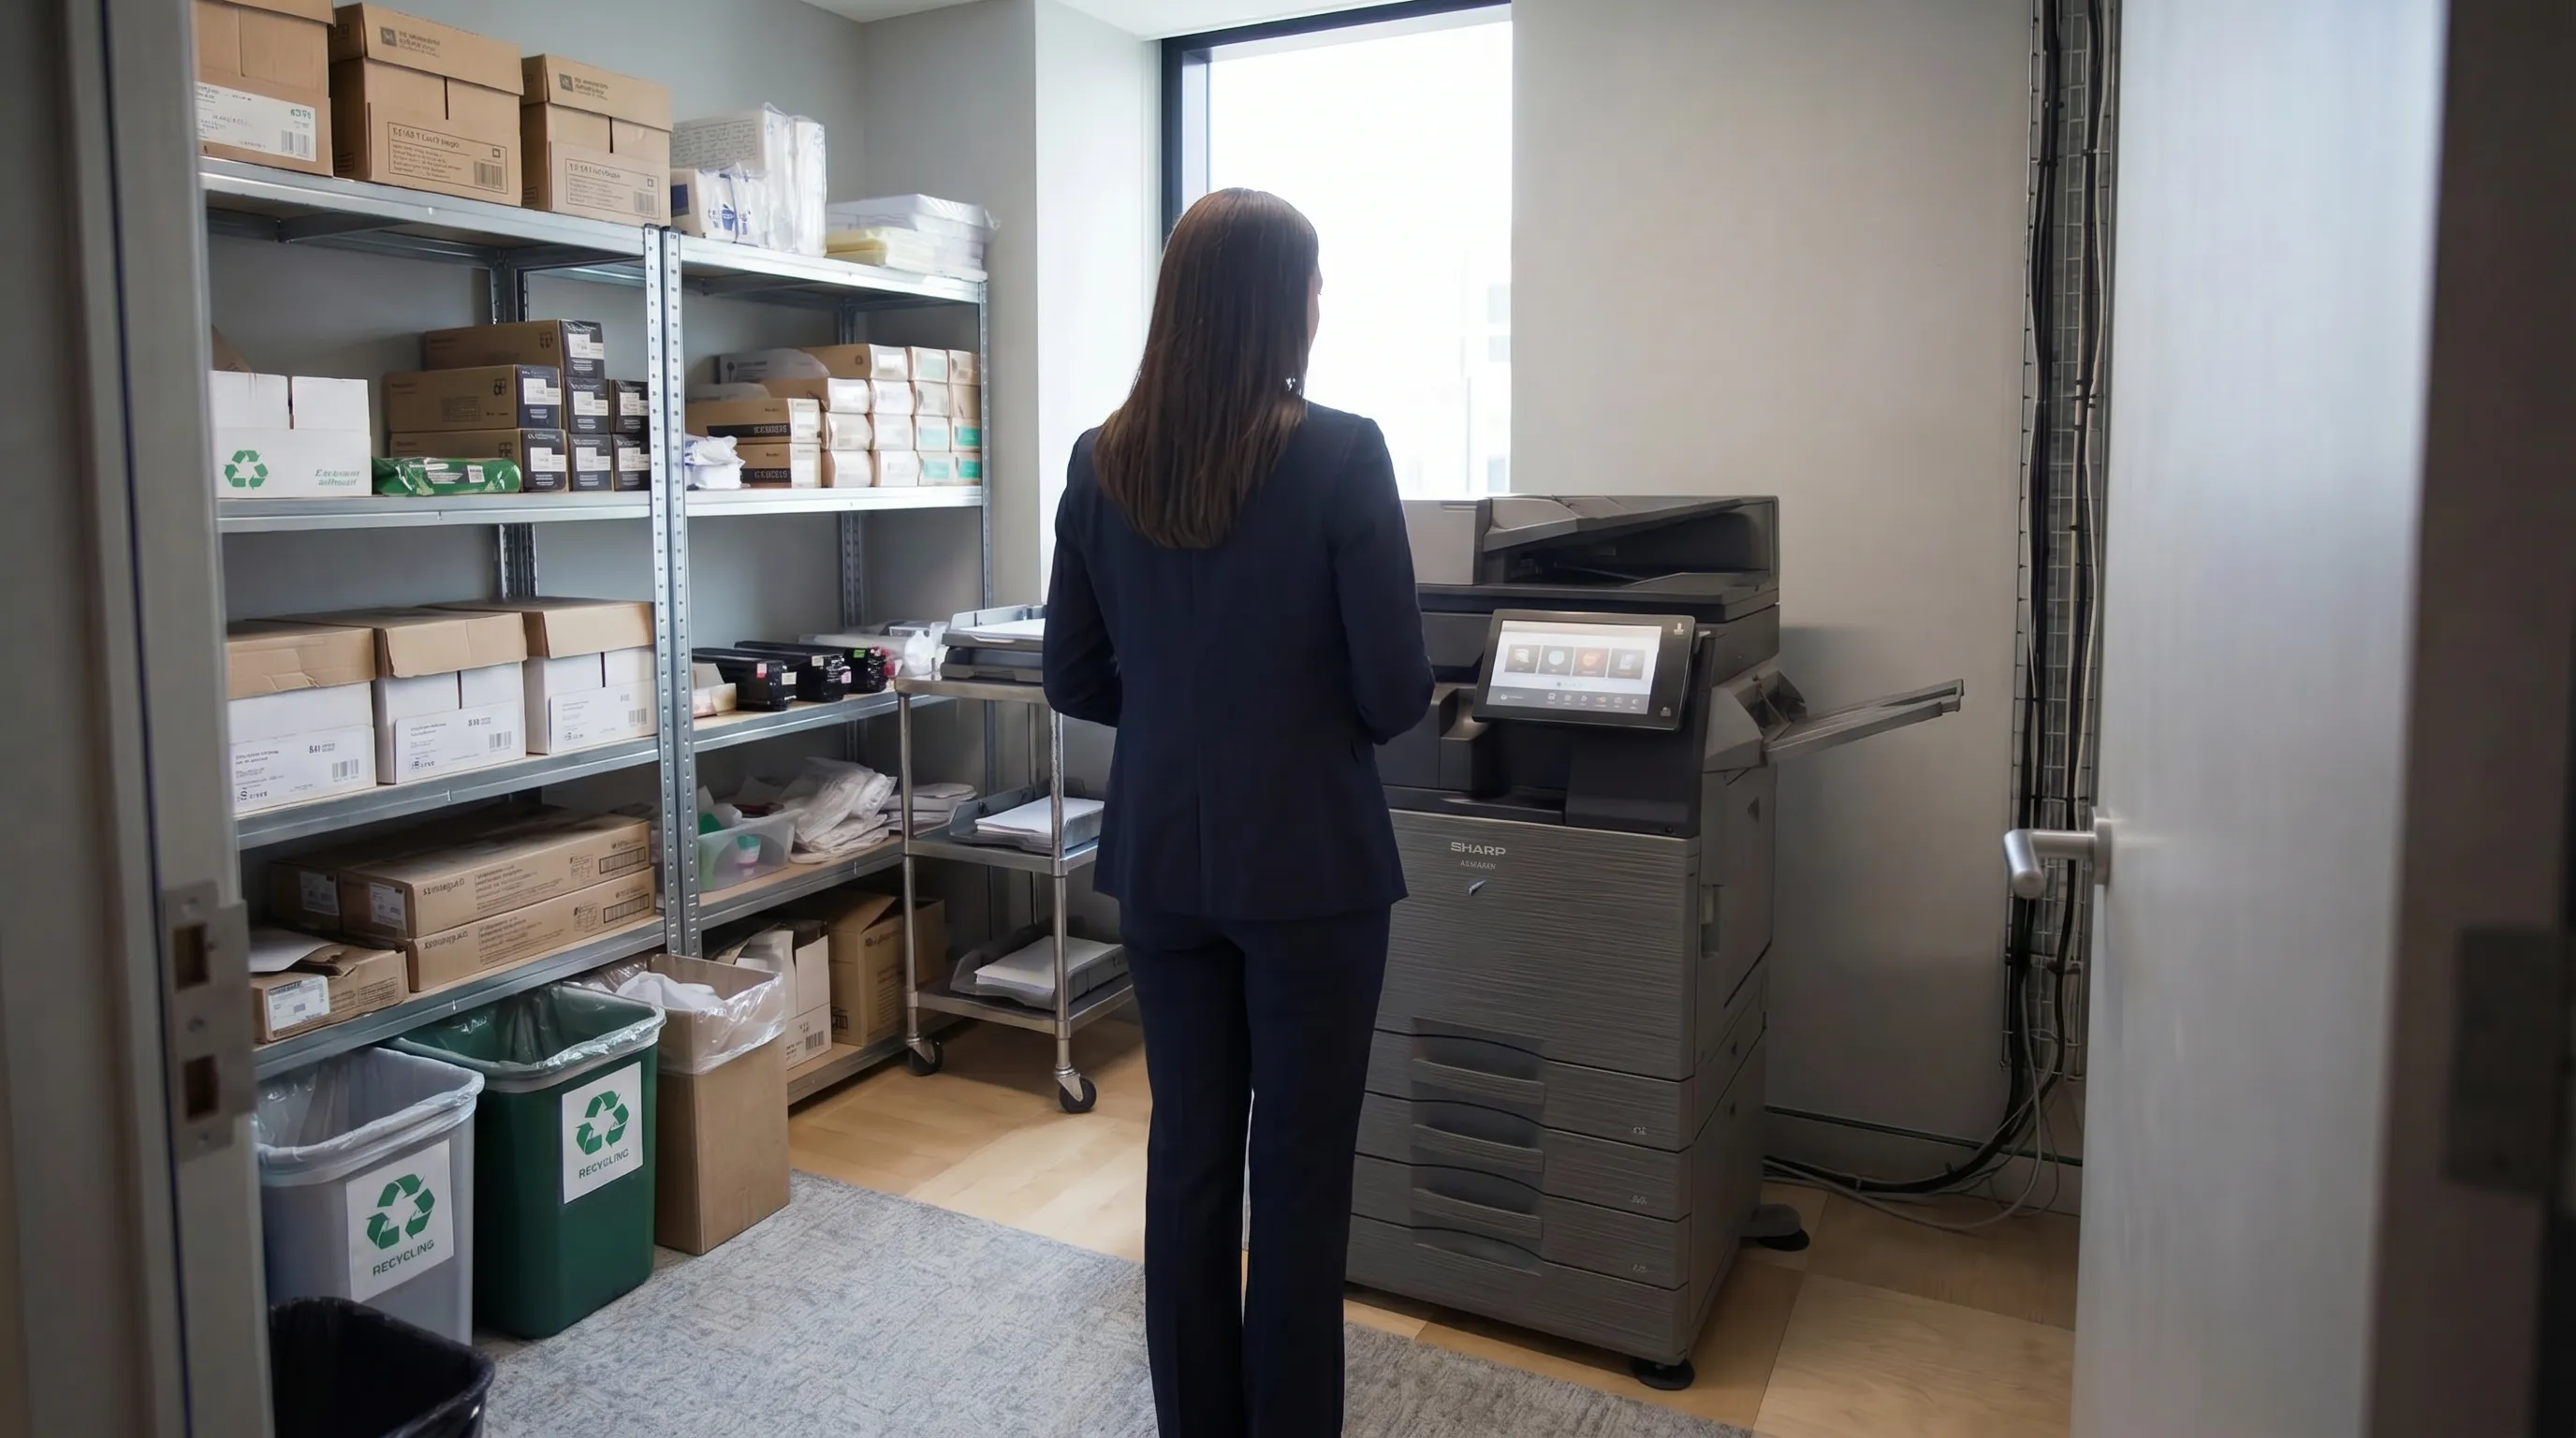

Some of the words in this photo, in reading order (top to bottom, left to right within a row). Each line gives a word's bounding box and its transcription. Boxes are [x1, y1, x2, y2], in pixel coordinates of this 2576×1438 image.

[1450, 842, 1506, 856] SHARP
[578, 1148, 630, 1180] RECYCLING
[373, 1239, 435, 1277] RECYCLING
